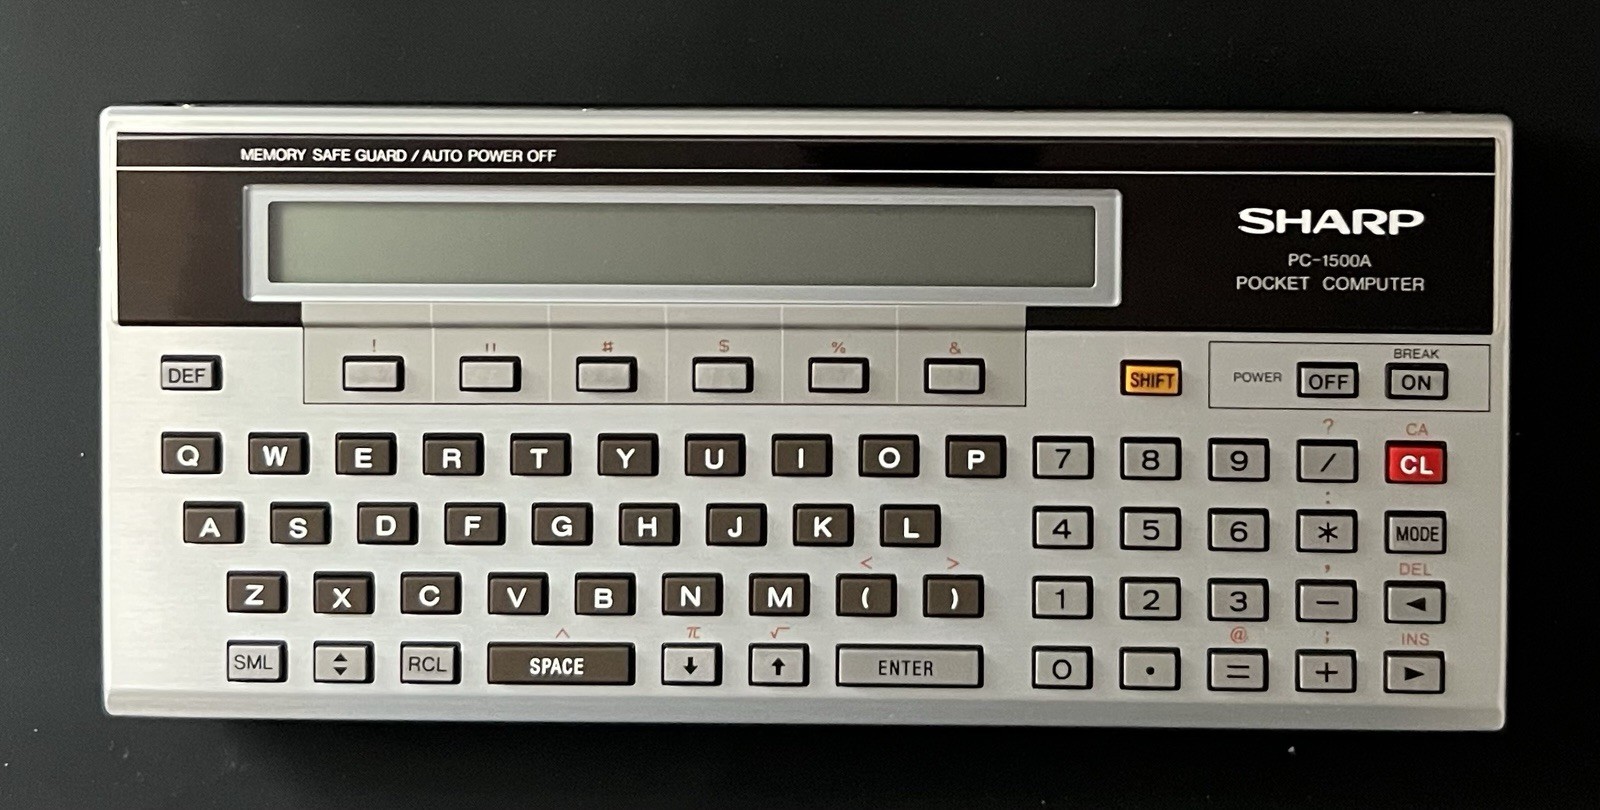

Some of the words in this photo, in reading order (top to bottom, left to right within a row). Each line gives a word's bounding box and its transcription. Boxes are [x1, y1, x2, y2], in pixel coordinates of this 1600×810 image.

[240, 148, 307, 162] MEMORY
[313, 149, 351, 161] SAFE
[355, 149, 408, 162] GUARD
[422, 149, 462, 162] AUTO
[468, 149, 523, 162] POWER
[527, 150, 556, 162] OFF
[1238, 208, 1424, 235] SHARP
[1288, 253, 1371, 267] PC-1500A
[1237, 276, 1310, 290] POCKET
[1323, 277, 1424, 291] COMPUTER
[1394, 349, 1439, 359] BREAK
[169, 368, 205, 383] DEF
[1129, 372, 1175, 389] SHIFT
[1234, 372, 1281, 382] POWER
[1309, 374, 1348, 390] OFF
[1402, 375, 1431, 390] ON
[1406, 423, 1428, 436] CA
[177, 445, 199, 466] Q
[263, 445, 288, 466] W
[355, 448, 372, 468] E
[443, 449, 462, 468] R
[530, 449, 548, 468] T
[616, 448, 635, 468] Y
[705, 449, 723, 469] U
[798, 447, 804, 469] I
[879, 447, 900, 468] O
[968, 450, 985, 470] P
[1056, 449, 1071, 469] 7
[1142, 450, 1159, 470] 8
[1230, 451, 1248, 471] 9
[1401, 456, 1433, 474] CL
[199, 518, 220, 537] A
[289, 518, 307, 538] S
[376, 516, 396, 536] D
[465, 515, 481, 536] F
[552, 515, 572, 537] G
[638, 517, 657, 537] H
[728, 517, 742, 537] J
[814, 517, 832, 537] K
[904, 518, 919, 538] L
[1053, 519, 1071, 539] 4
[1143, 520, 1159, 540] 5
[1230, 521, 1247, 542] 6
[1397, 526, 1439, 541] MODE
[1400, 563, 1431, 576] DEL
[245, 584, 264, 605] Z
[333, 587, 351, 608] X
[419, 585, 439, 606] C
[507, 587, 526, 608] V
[595, 587, 613, 608] B
[681, 586, 700, 607] N
[768, 587, 792, 607] M
[1056, 589, 1064, 609] 1
[1143, 590, 1159, 610] 2
[1230, 591, 1247, 612] 3
[1402, 633, 1429, 646] INS
[235, 655, 273, 669] SML
[409, 657, 446, 672] RCL
[530, 657, 583, 675] SPACE
[879, 660, 932, 676] ENTER
